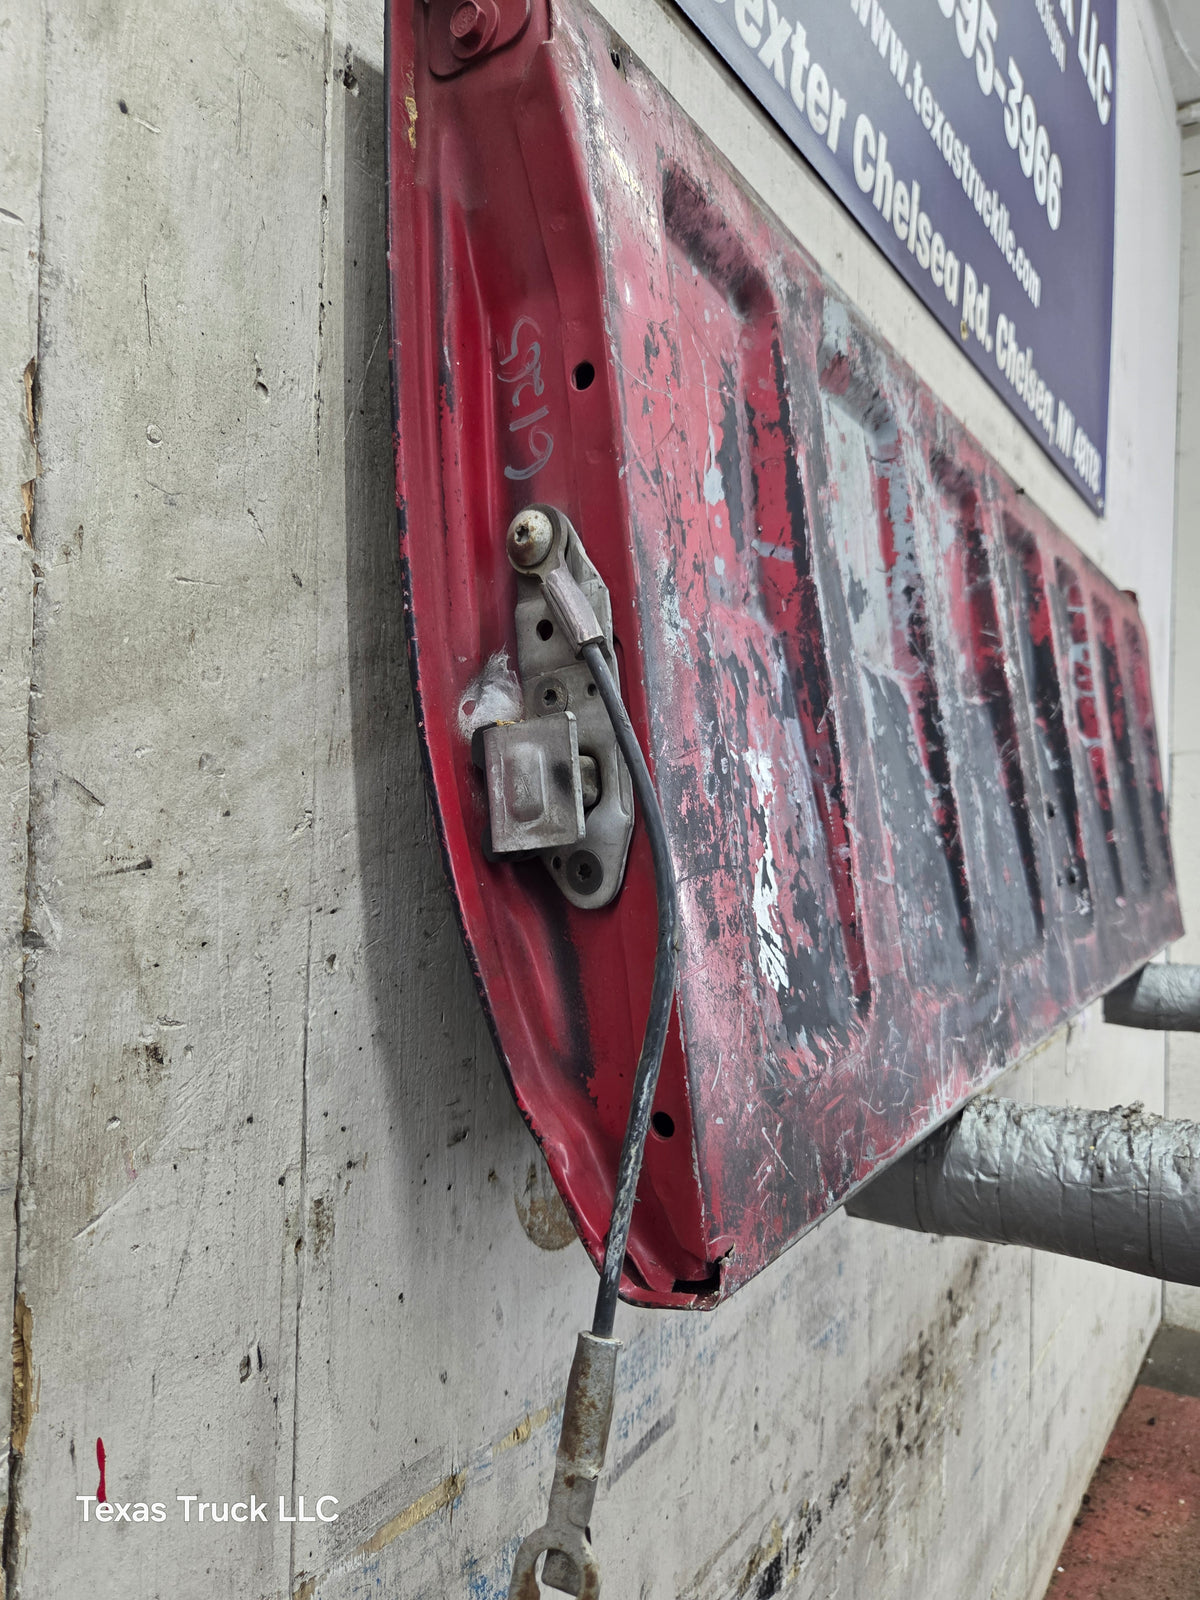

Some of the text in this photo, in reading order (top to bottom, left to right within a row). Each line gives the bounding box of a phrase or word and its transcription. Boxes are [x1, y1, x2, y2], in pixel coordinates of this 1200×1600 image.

[938, 0, 1062, 230] 95-3966
[1078, 0, 1113, 125] LLC
[714, 0, 847, 154] exter
[853, 113, 960, 307] Chelsea
[962, 262, 993, 352] Rd.
[996, 313, 1056, 445] Chelsea,
[1055, 400, 1075, 458] MI
